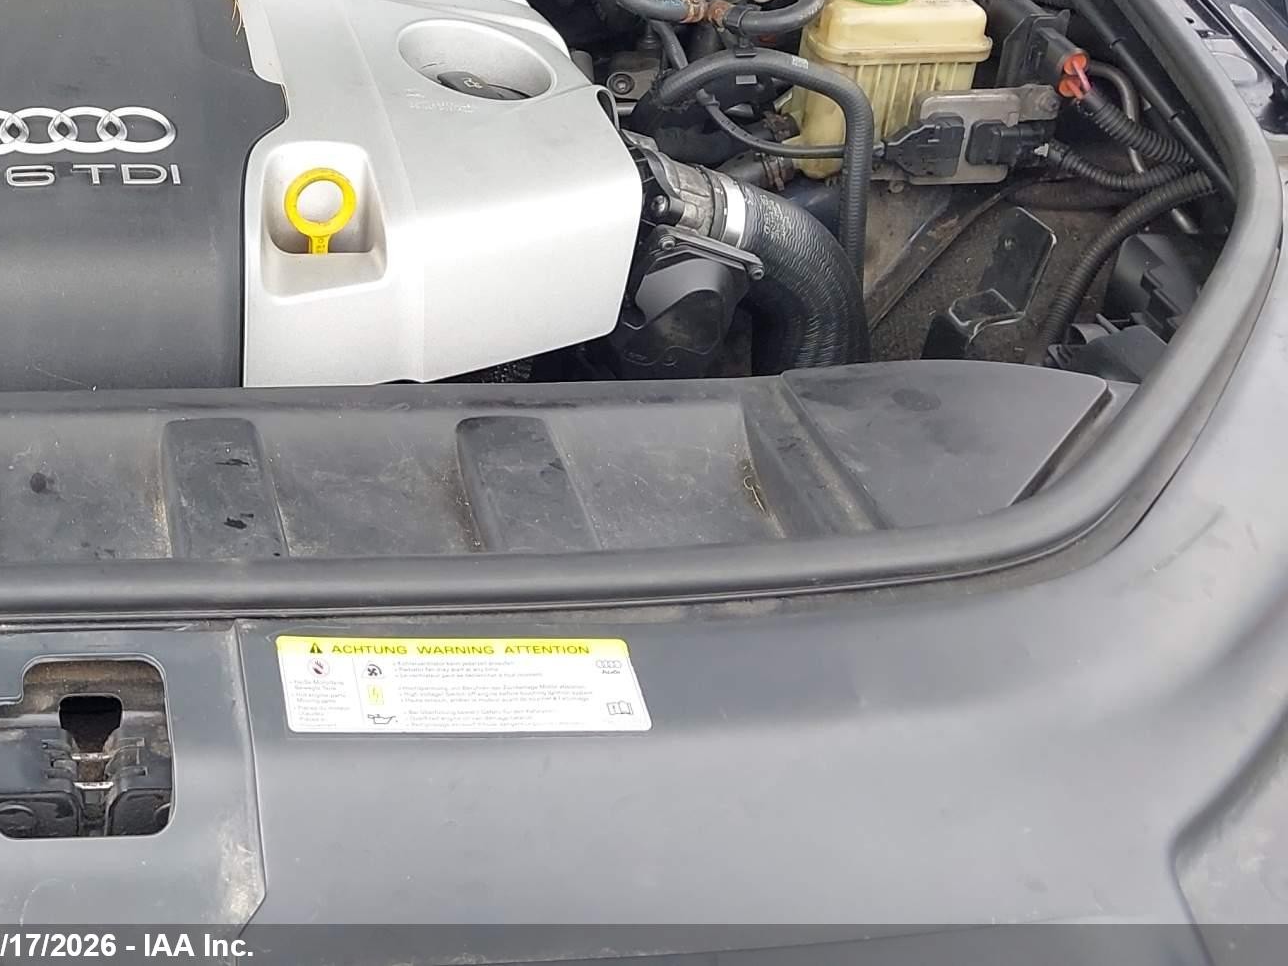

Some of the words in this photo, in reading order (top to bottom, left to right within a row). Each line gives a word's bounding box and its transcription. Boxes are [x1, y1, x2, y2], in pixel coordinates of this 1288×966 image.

[72, 164, 181, 186] TDI
[331, 644, 408, 655] ACHTUNG
[416, 644, 495, 655] WARNING
[504, 644, 590, 655] ATTENTION
